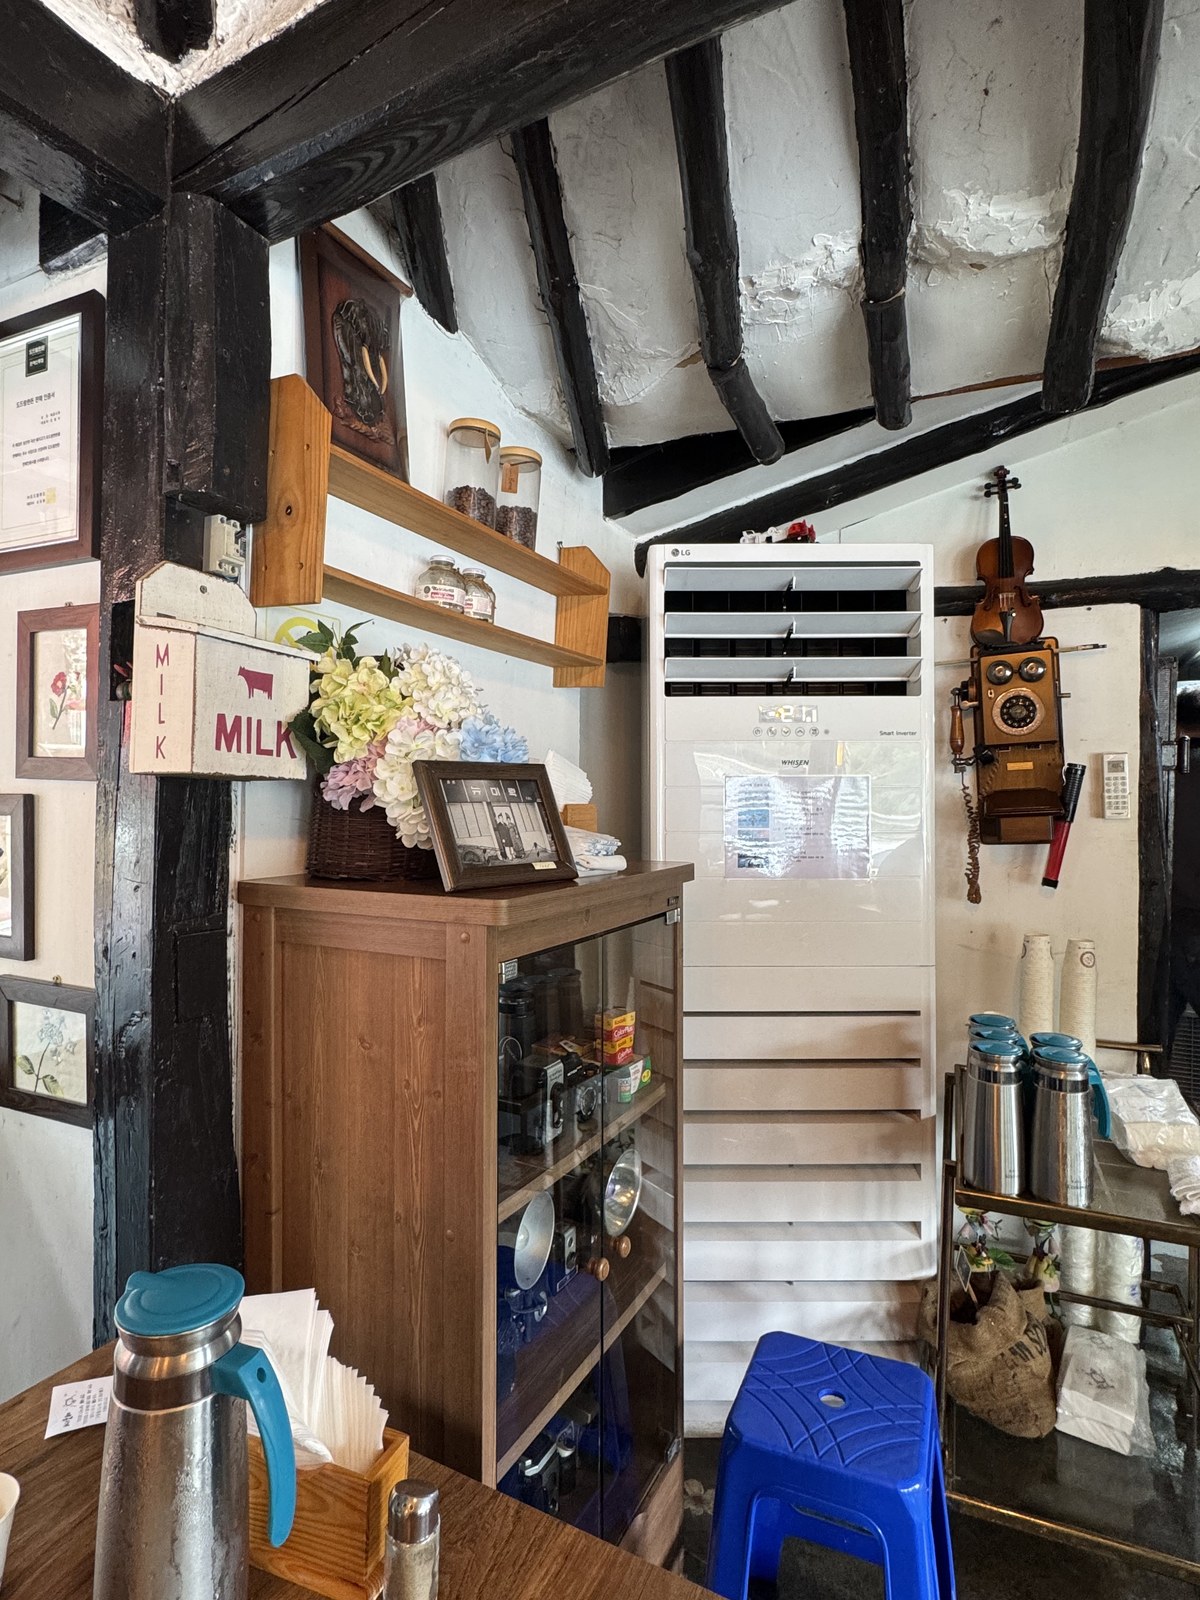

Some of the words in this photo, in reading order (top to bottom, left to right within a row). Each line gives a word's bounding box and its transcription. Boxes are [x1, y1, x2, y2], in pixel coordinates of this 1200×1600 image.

[154, 643, 170, 760] MILK
[214, 713, 298, 760] MILK
[781, 759, 810, 768] WHISEN
